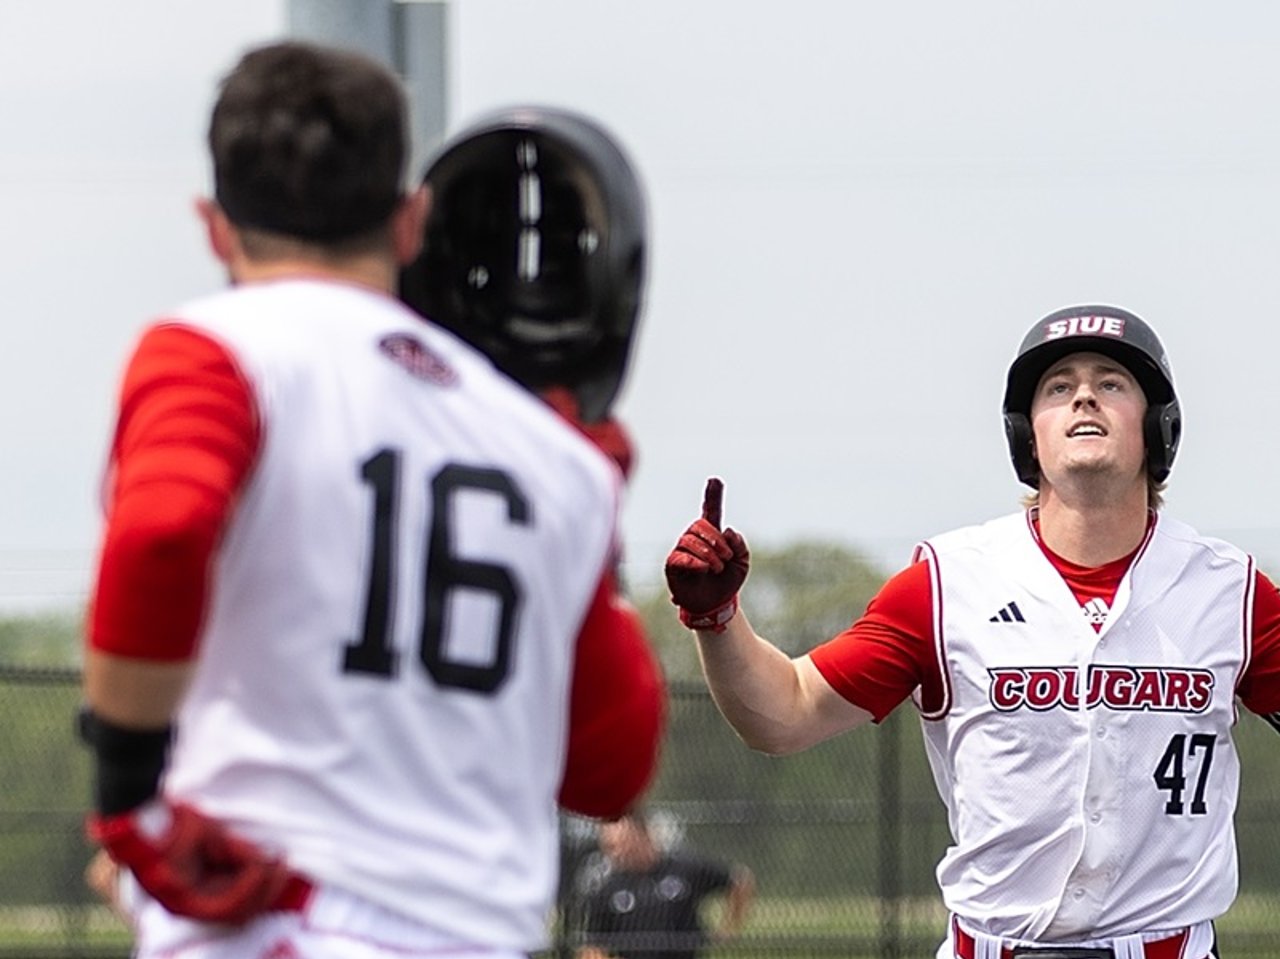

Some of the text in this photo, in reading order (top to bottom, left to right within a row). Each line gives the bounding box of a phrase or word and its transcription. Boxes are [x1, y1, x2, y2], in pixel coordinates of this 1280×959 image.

[1044, 314, 1125, 340] SIUE
[338, 447, 532, 696] 16
[988, 665, 1215, 713] COUGARS
[1152, 733, 1218, 815] 47
